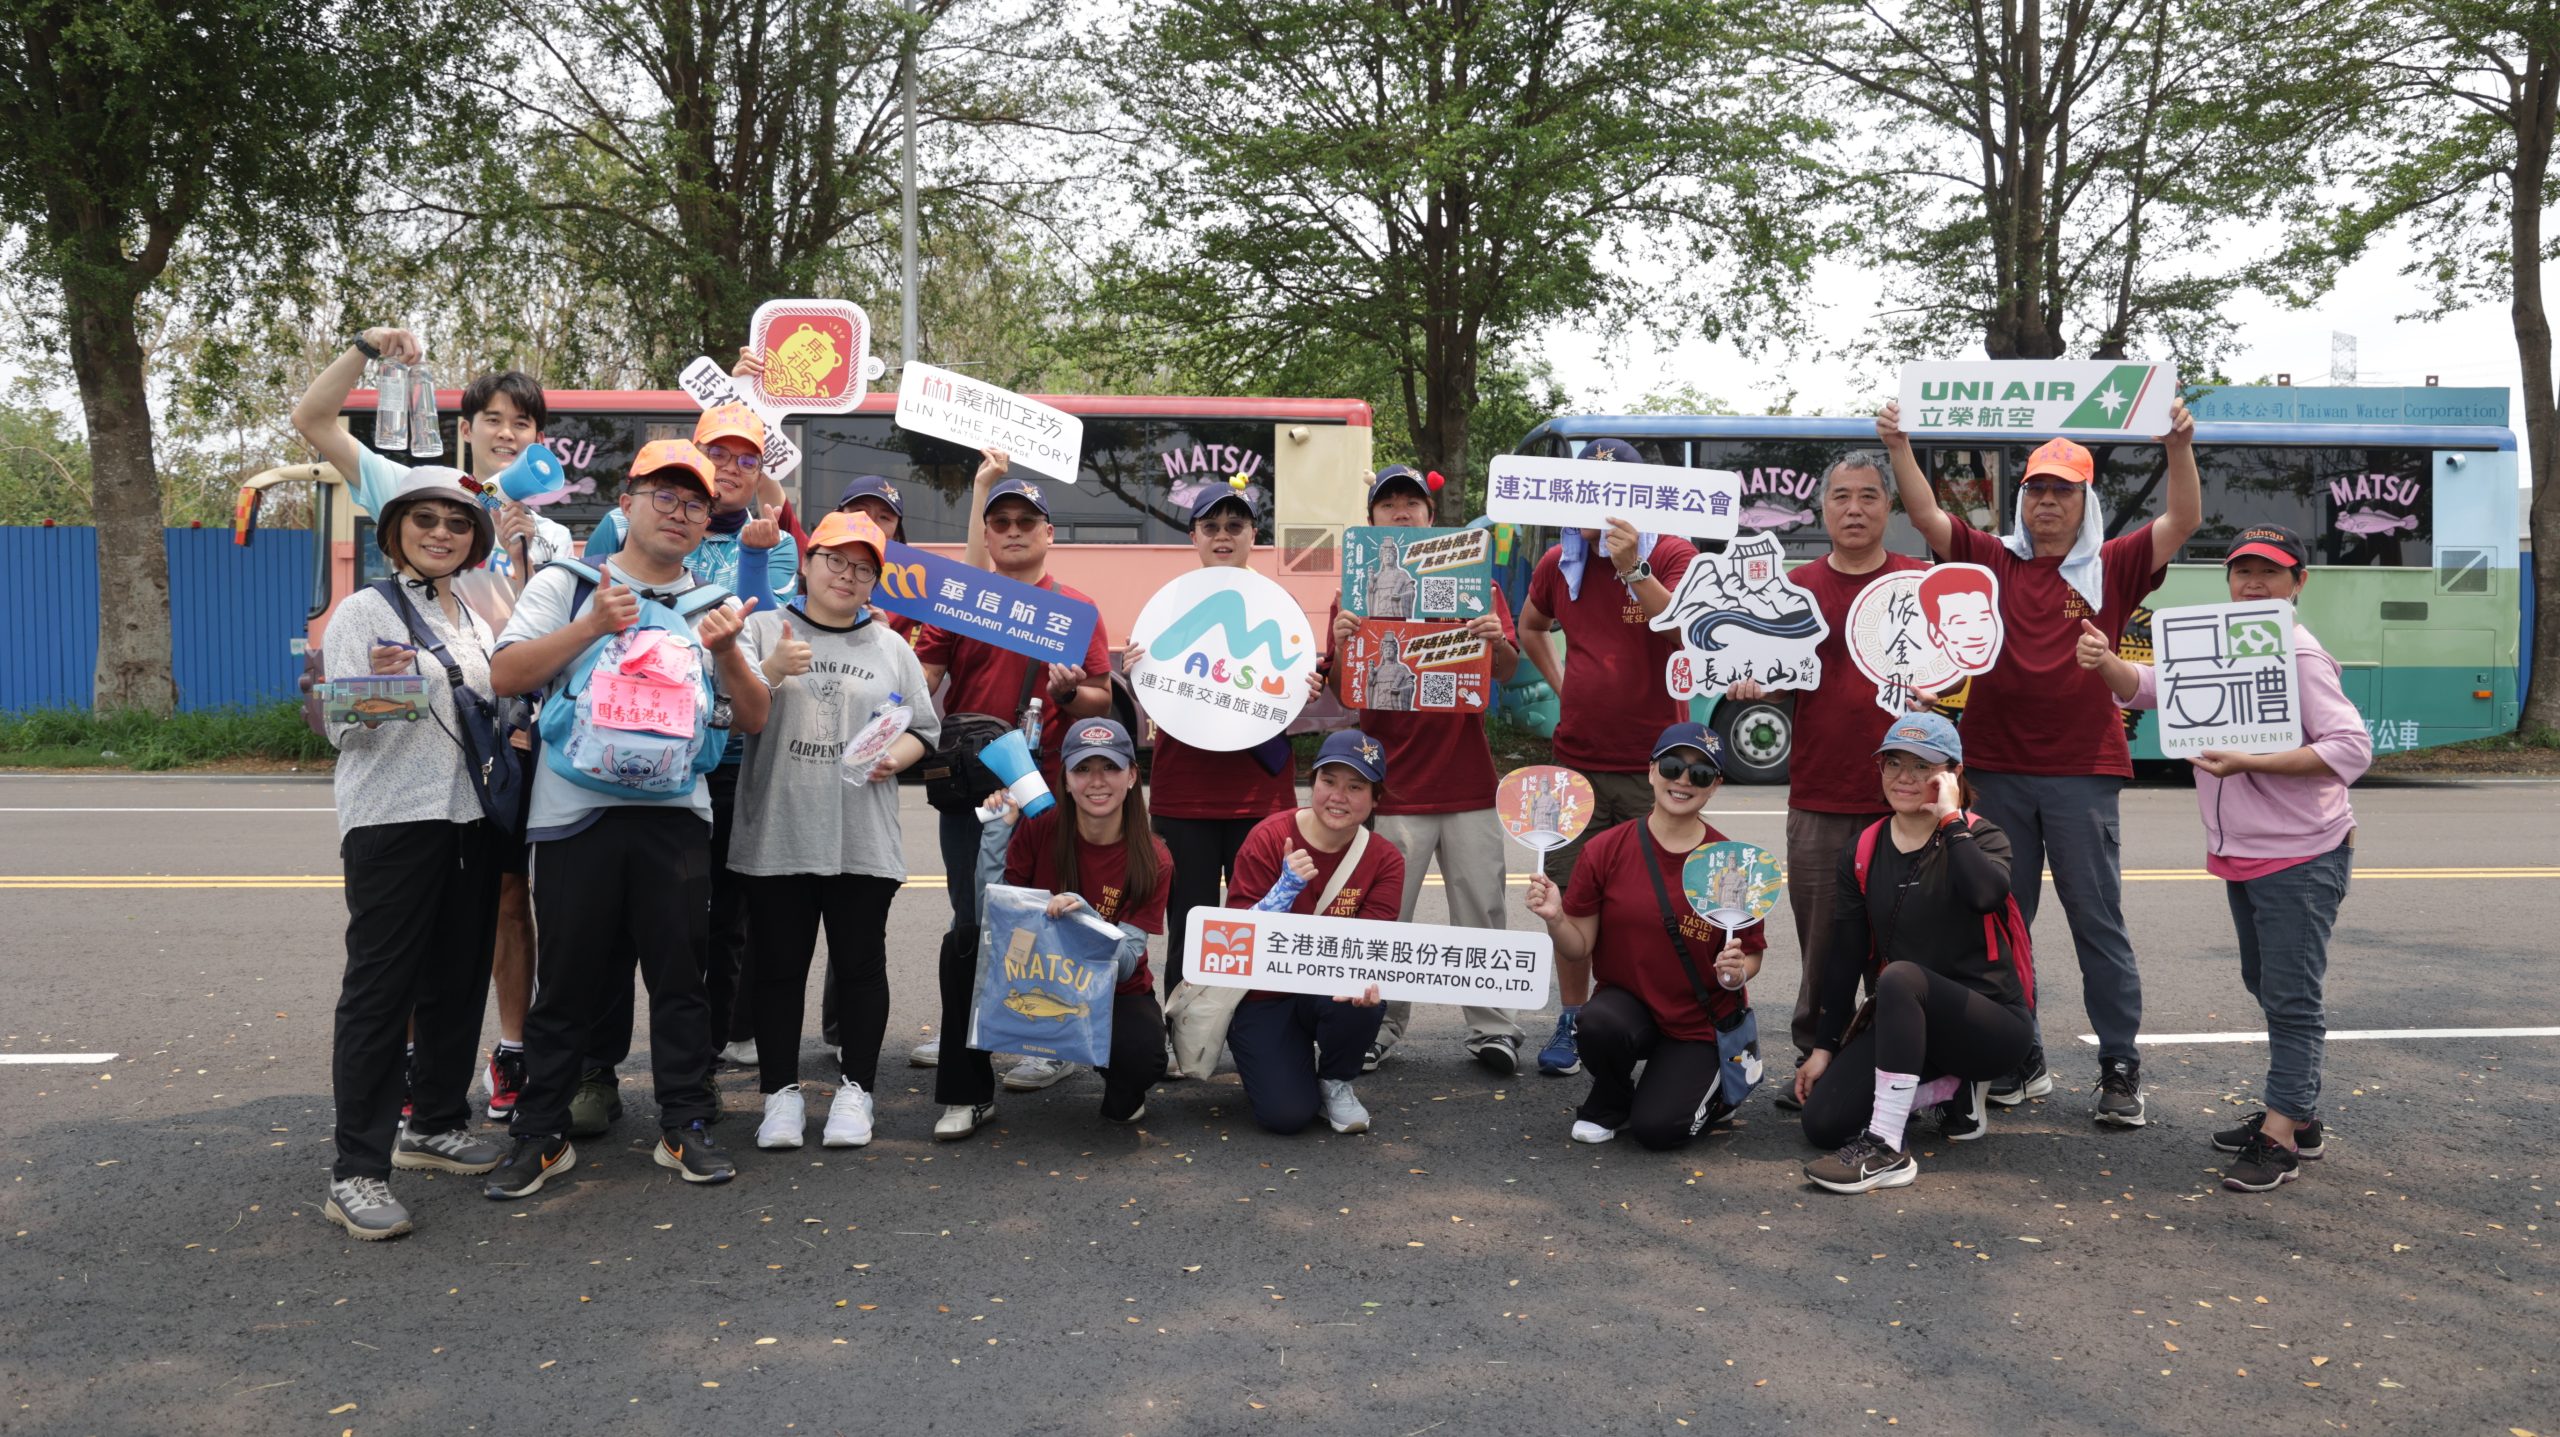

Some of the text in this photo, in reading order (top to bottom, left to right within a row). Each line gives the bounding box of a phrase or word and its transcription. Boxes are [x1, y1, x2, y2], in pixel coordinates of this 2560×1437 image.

[787, 338, 828, 373] 馬祖
[1921, 381, 2075, 401] UNI AIR
[1918, 406, 2035, 428] 立榮航空
[2356, 403, 2398, 418] Water
[904, 400, 1073, 465] LIN YIHE FACTORY
[950, 427, 981, 442] MATSU
[1162, 444, 1262, 479] MATSU
[1495, 474, 1733, 517] 連江縣旅行同業公會
[2330, 473, 2420, 506] MATSU
[2245, 529, 2285, 542] Taiwan
[939, 578, 1073, 637] 華信航空
[934, 602, 1065, 652] MANDARIN AIRLINES
[841, 663, 875, 681] HELP
[1139, 671, 1288, 724] 連江縣交通旅遊局
[2168, 731, 2294, 748] MATSU SOUVENIR
[1337, 897, 1357, 906] TIME
[1679, 925, 1695, 938] THE
[1203, 952, 1250, 974] APT
[1267, 931, 1537, 973] 全港通航業股份有限公司
[1004, 953, 1094, 993] MATSU
[1266, 961, 1534, 993] ALL PORTS TRANSPORTATON CO., LTD.
